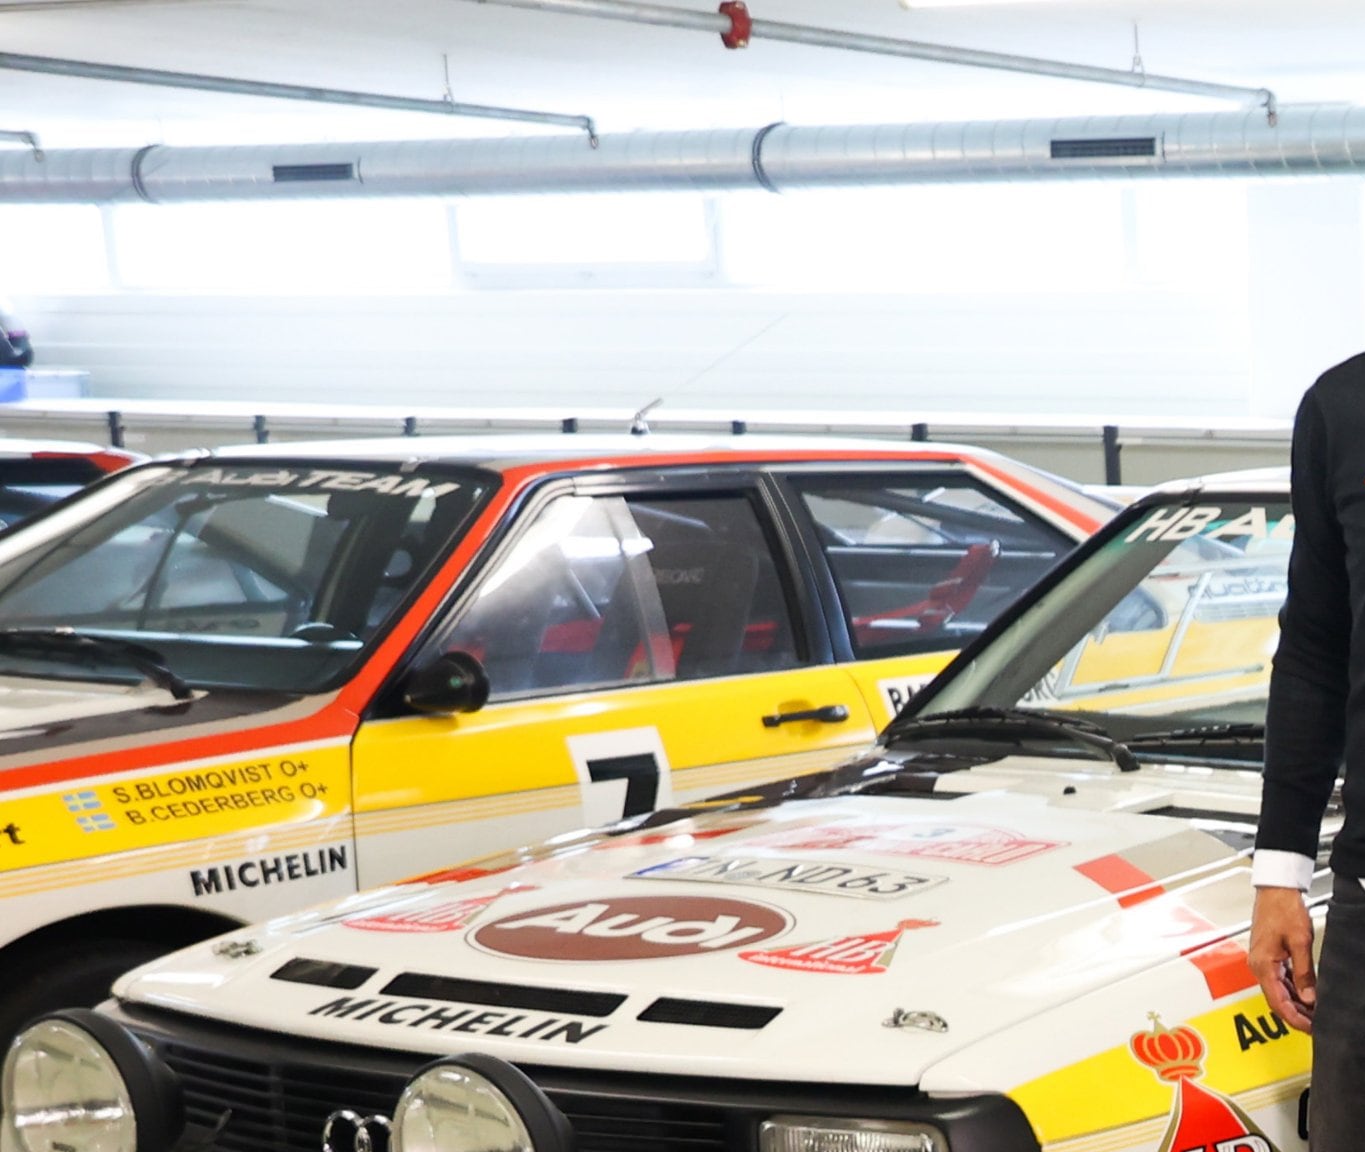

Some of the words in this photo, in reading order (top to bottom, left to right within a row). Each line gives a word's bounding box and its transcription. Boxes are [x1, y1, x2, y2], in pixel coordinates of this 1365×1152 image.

[181, 470, 297, 487] Audi
[297, 470, 461, 497] TEAM
[1124, 507, 1222, 543] HB
[113, 764, 272, 803] S.BLOMQVIST
[586, 753, 660, 819] 7
[126, 788, 295, 825] B.CEDERBERG
[190, 846, 348, 896] MICHELIN
[495, 903, 763, 949] Audi
[308, 997, 608, 1043] MICHELIN
